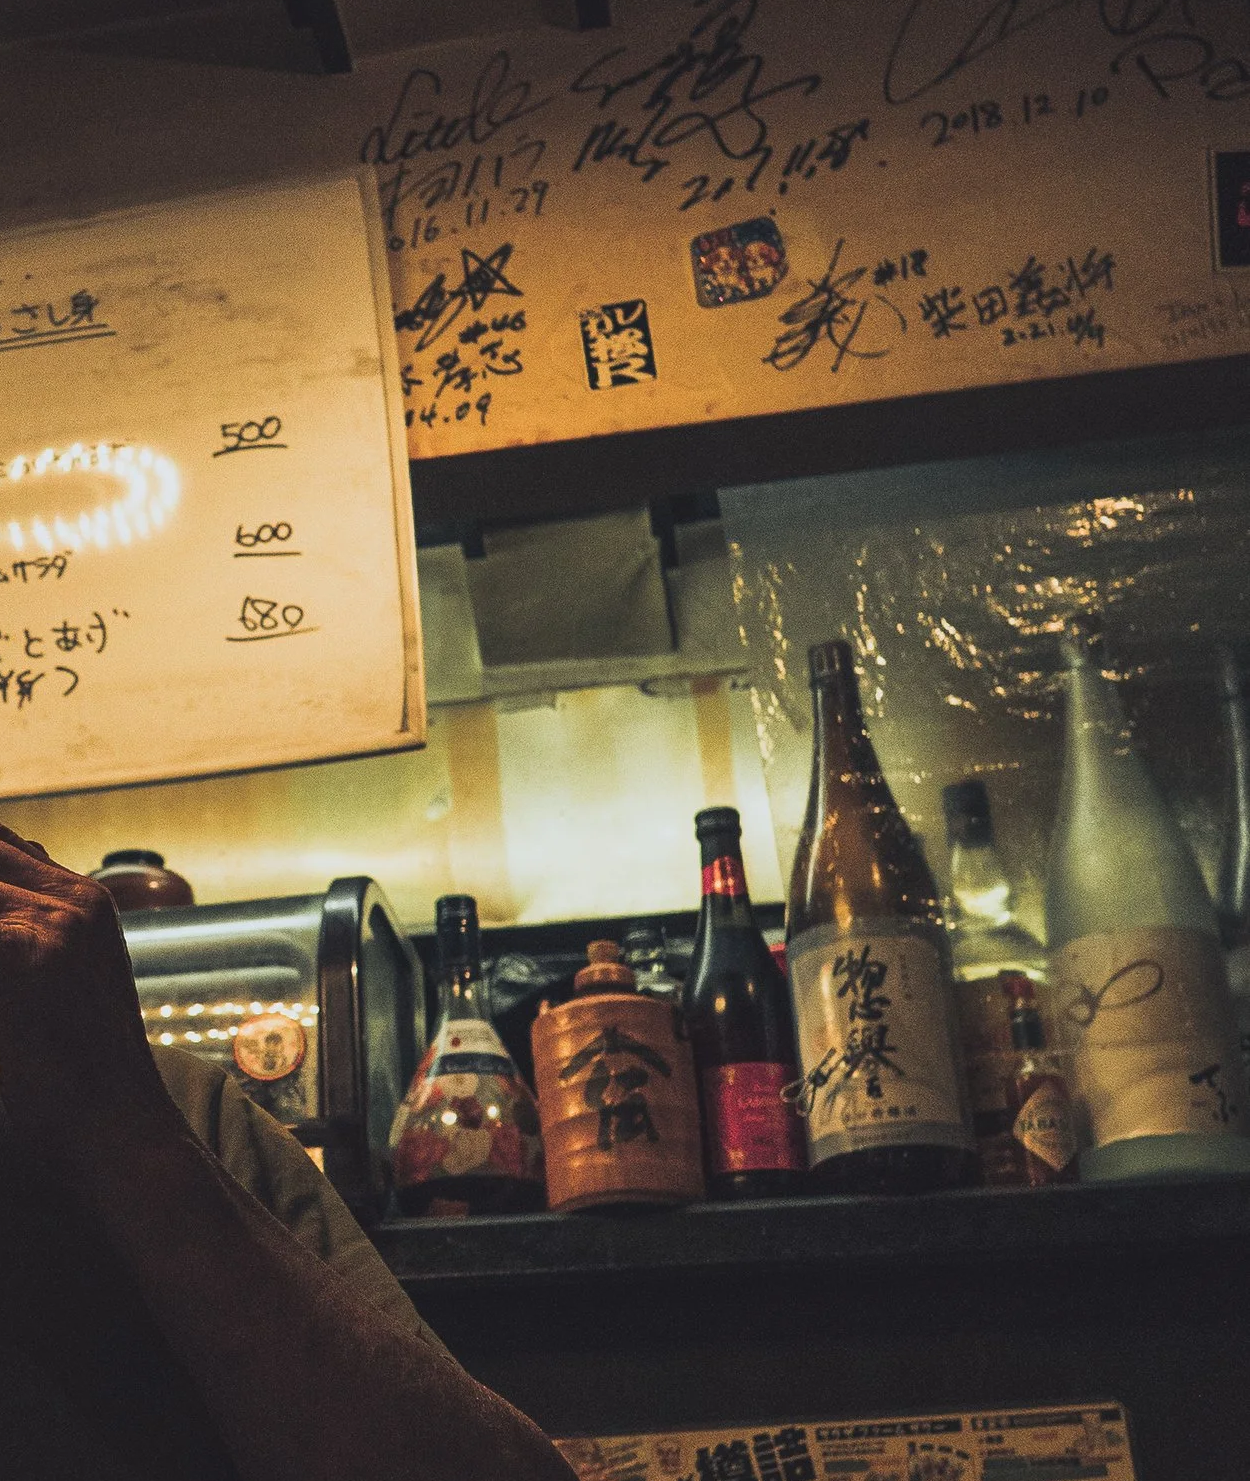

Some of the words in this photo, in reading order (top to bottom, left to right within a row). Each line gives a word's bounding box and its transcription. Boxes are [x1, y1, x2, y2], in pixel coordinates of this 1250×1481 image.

[921, 100, 1002, 147] 2018
[220, 416, 282, 452] 500
[236, 522, 293, 547] 600
[238, 596, 304, 631] 680
